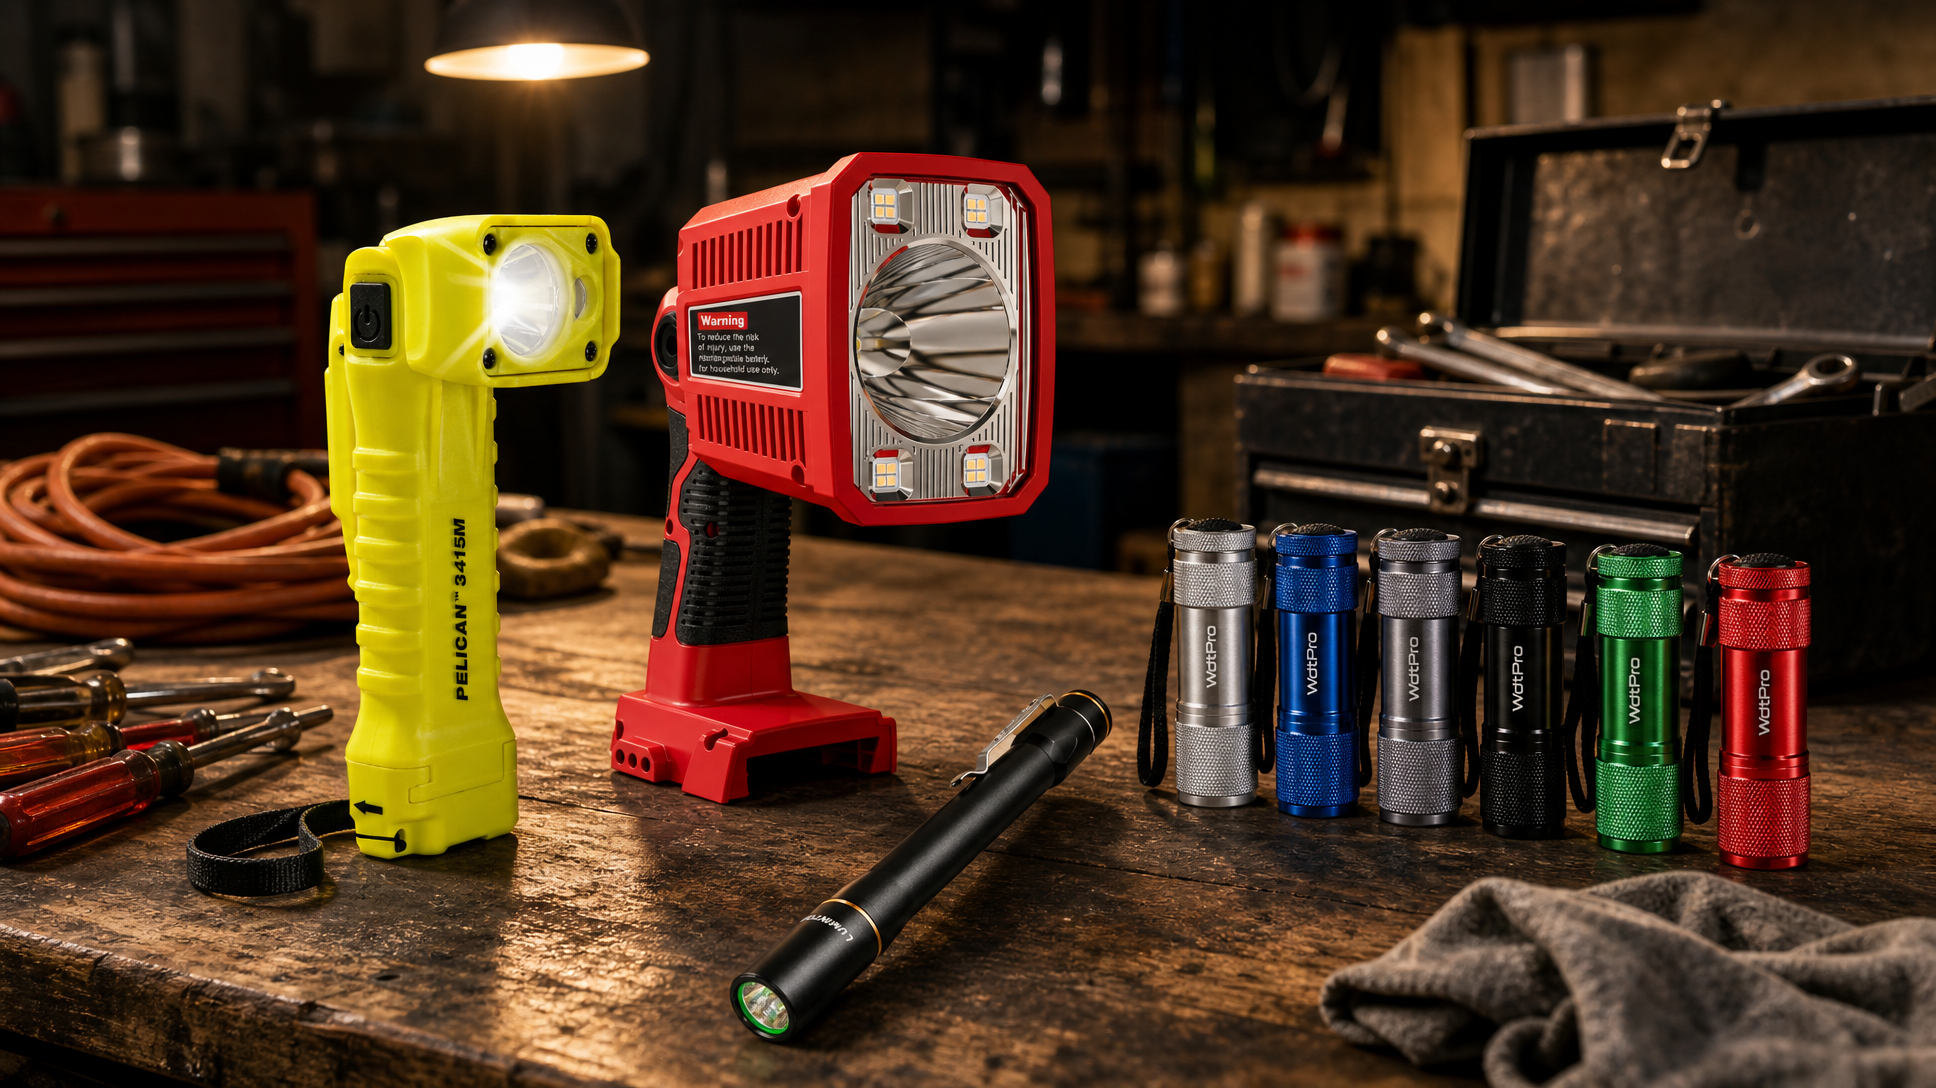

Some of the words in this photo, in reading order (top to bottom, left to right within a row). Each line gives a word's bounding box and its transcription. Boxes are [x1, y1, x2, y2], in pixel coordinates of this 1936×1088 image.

[697, 332, 706, 341] To
[707, 332, 731, 341] reduce
[700, 315, 745, 328] Warning
[743, 344, 755, 352] the
[453, 517, 468, 587] 3415M
[1205, 625, 1217, 689] WdtPro
[1306, 632, 1318, 696] WdtPro
[1408, 636, 1420, 702] WdtPro
[1512, 645, 1524, 712] WdtPro
[1628, 657, 1640, 725] WdtPro
[1758, 669, 1771, 736] WdtPro
